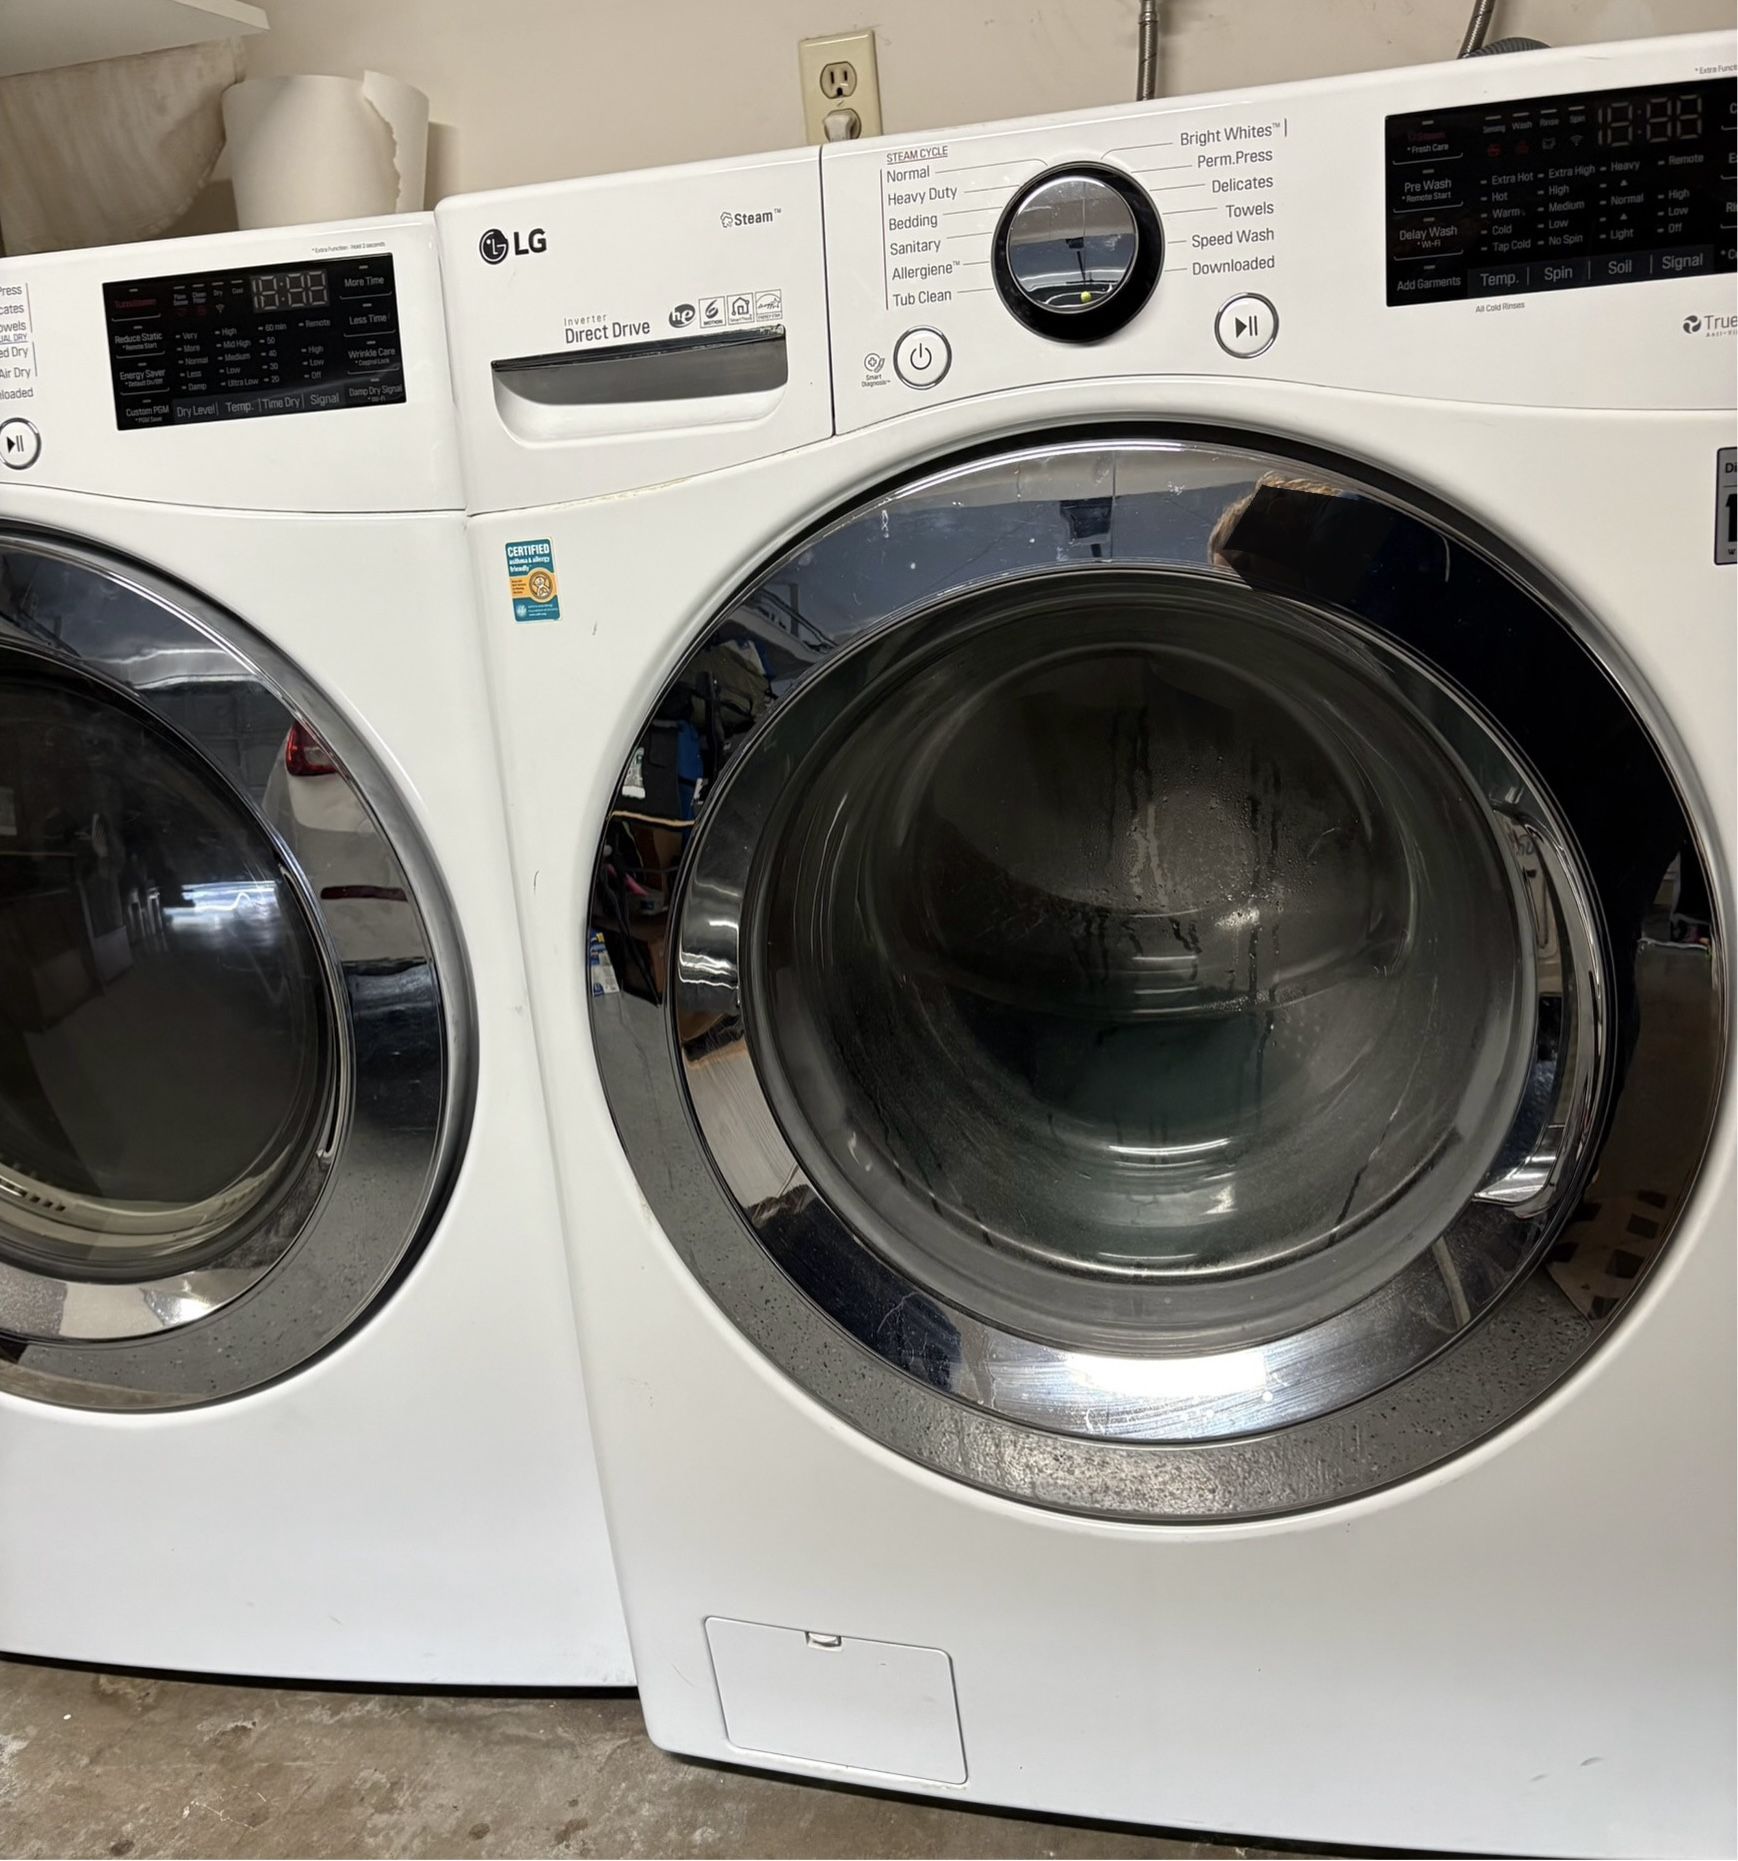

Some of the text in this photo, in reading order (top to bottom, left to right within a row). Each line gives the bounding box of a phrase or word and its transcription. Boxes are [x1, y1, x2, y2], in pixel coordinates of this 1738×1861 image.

[1180, 129, 1221, 147] Bright
[886, 145, 948, 163] STEAM CYCLE
[1197, 150, 1273, 168] Perm.Press
[1668, 154, 1704, 166] Remote
[1549, 164, 1596, 179] Extra High
[1610, 160, 1641, 172] Heavy
[887, 165, 930, 183] Normal
[1491, 172, 1534, 185] Extra Hot
[1212, 176, 1274, 193] Delicates
[1404, 178, 1451, 192] Pre Wash
[1549, 184, 1570, 196] High
[888, 186, 958, 206] Heavy Duty
[1491, 192, 1508, 202] Hot
[1610, 193, 1645, 205] Normal
[1668, 188, 1691, 201] High
[1225, 201, 1274, 218] Towels
[1549, 200, 1586, 212] Medium
[1668, 206, 1689, 217] Low
[1492, 208, 1520, 218] Warm
[889, 214, 938, 232] Bedding
[1549, 219, 1569, 229] Low
[1668, 222, 1683, 234] Off
[1400, 225, 1458, 242] Delay Wash
[1491, 224, 1512, 236] Cold
[1610, 228, 1635, 240] Light
[514, 228, 546, 256] LG
[1192, 227, 1274, 250] Speed Wash
[1549, 233, 1584, 246] No Spin
[890, 240, 941, 256] Sanitary
[1492, 238, 1532, 252] Tap Cold
[1192, 255, 1275, 275] Downloaded
[1480, 272, 1519, 287] Temp.
[1543, 265, 1573, 283] Spin
[1608, 259, 1632, 275] Soil
[1661, 252, 1704, 271] Signal
[344, 276, 384, 288] More Time
[1397, 276, 1462, 291] Add Garments
[892, 290, 952, 307] Tub Clean
[1486, 303, 1501, 312] Cold
[1502, 301, 1525, 310] Rinses
[349, 313, 387, 325] Less Time
[564, 314, 607, 326] Inverter
[114, 332, 163, 344] Reduce Static
[182, 332, 198, 341] Very
[221, 327, 237, 337] High
[565, 321, 650, 344] Direct Drive
[236, 338, 252, 349] High
[308, 345, 324, 354] High
[11, 346, 28, 358] Dry
[224, 352, 252, 362] Medium
[347, 347, 396, 359] Wrinkle Care
[309, 359, 325, 367] Low
[14, 367, 31, 378] Dry
[119, 369, 167, 381] Energy Saver
[226, 366, 241, 375] Low
[244, 377, 259, 386] Low
[270, 375, 280, 383] 20
[349, 384, 403, 397] Damp Dry Signal
[126, 404, 170, 417] Custom PGM
[176, 392, 340, 417] Dry Level Temp. Time Dry Signal
[507, 543, 550, 557] CERTIFIED
